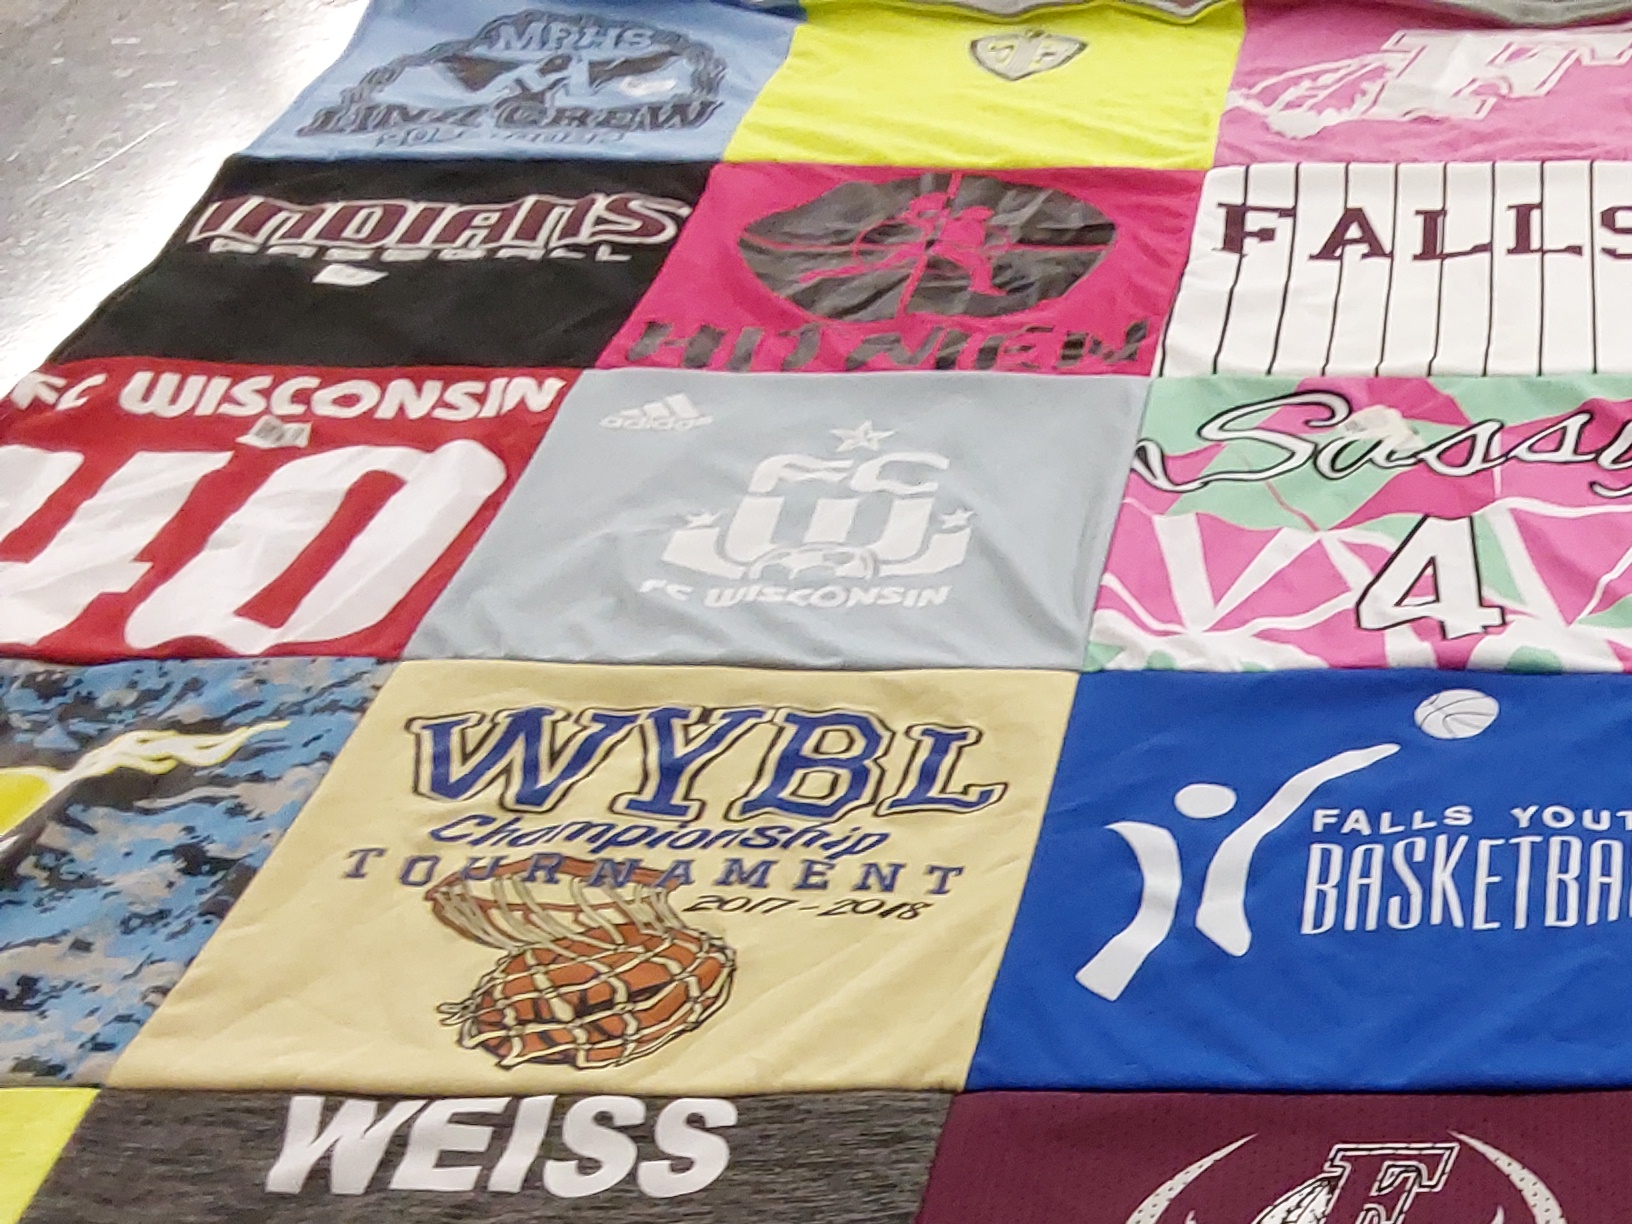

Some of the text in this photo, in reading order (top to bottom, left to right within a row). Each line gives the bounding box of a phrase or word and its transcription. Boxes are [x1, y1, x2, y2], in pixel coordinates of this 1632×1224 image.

[186, 191, 692, 248] INDIANS
[10, 370, 568, 422] FC WISCONSIN
[747, 452, 951, 494] FC
[0, 438, 508, 656] 40
[638, 578, 953, 609] FC WISCONSIN
[1355, 514, 1507, 641] 4
[404, 704, 1009, 826] WYBL
[428, 813, 891, 862] Championship
[1311, 805, 1474, 836] FALLS
[341, 847, 965, 897] TOURNAMENT
[265, 1094, 739, 1198] WEISS
